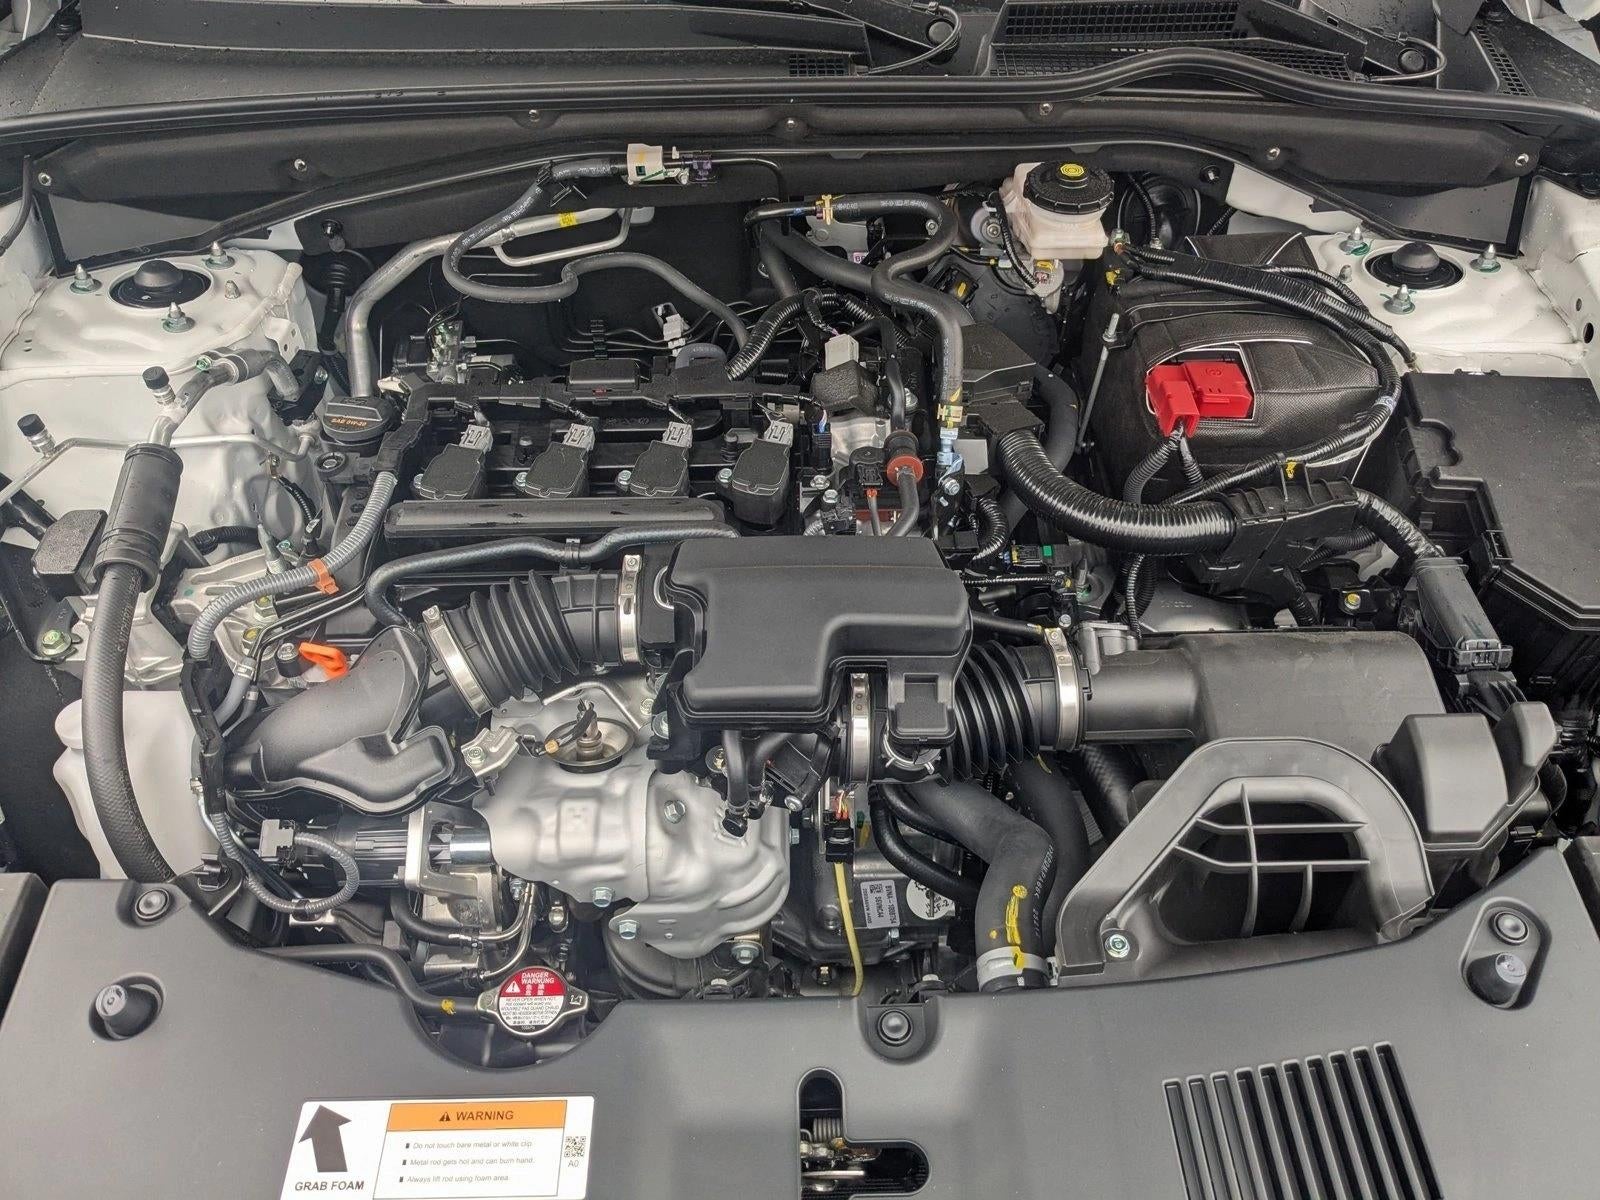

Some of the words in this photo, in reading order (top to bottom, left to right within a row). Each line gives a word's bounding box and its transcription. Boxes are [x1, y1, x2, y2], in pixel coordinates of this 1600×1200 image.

[456, 1110, 514, 1121] WARNING
[294, 1181, 328, 1191] GRAB
[331, 1180, 365, 1191] FOAM
